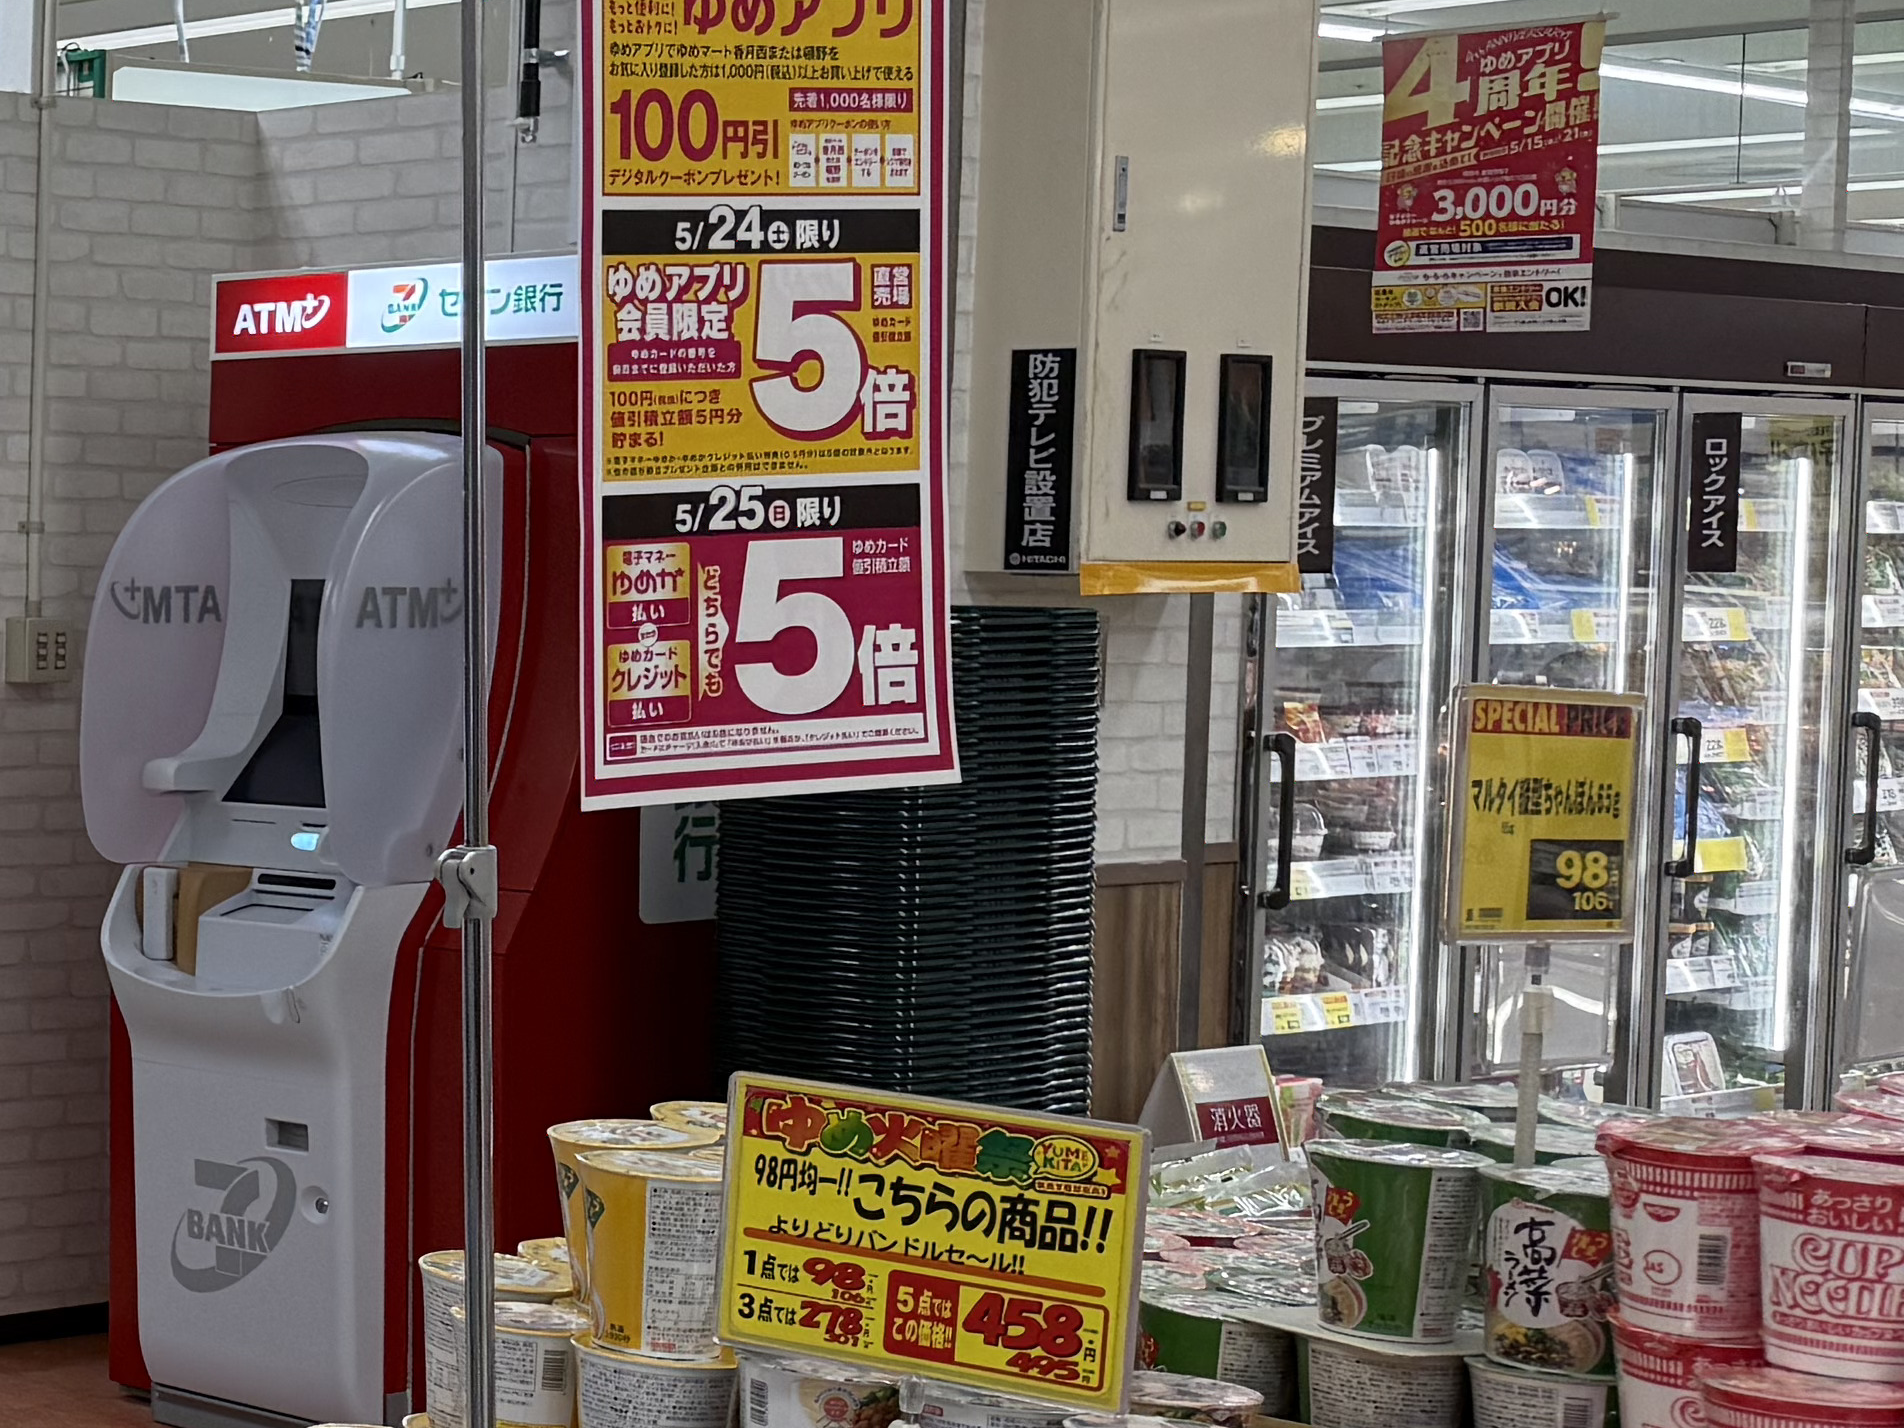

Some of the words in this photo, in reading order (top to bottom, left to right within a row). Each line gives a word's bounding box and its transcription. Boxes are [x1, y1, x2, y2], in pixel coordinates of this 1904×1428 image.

[1479, 40, 1571, 74] ゆめアプリ
[793, 92, 908, 109] 先着1,000名様限り
[609, 88, 780, 162] 100円引
[608, 169, 780, 188] デジタルクーポンプレゼント!
[1431, 182, 1578, 222] 3,000円分
[607, 263, 747, 302] ゆめアプリ
[1545, 285, 1587, 308] OK!
[616, 302, 730, 341] 会員限定
[611, 432, 664, 448] 貯まる!
[1020, 352, 1060, 548] 防犯テレビ設置店
[1297, 414, 1325, 556] プレミアムアイス
[1700, 437, 1728, 548] ロックアイス
[622, 550, 677, 565] 電子マネー
[852, 538, 909, 554] ゆめカード
[1022, 553, 1067, 565] HITACHI
[631, 603, 665, 622] 払い
[704, 565, 723, 698] どちらでも
[618, 647, 678, 663] ゆめカード
[611, 664, 688, 692] クレジット
[631, 701, 664, 720] 払い
[1474, 700, 1561, 733] SPECIAL
[1556, 850, 1610, 890] 98
[1572, 891, 1609, 912] 106
[1210, 1103, 1262, 1132] 消火器
[754, 1153, 851, 1198] 98円均一!!
[853, 1171, 1114, 1254] こちらの商品!!
[1809, 1188, 1893, 1214] あっさり
[186, 1206, 276, 1253] BANK
[1805, 1208, 1894, 1232] おいしい
[743, 1249, 800, 1284] 1点では
[802, 1256, 868, 1292] 98
[1503, 1249, 1522, 1307] ラーメン
[1513, 1216, 1557, 1318] 高菜
[736, 1292, 797, 1327] 3点では
[798, 1300, 865, 1338] 278
[896, 1285, 953, 1317] 5点では
[891, 1319, 953, 1351] この価格!!
[961, 1292, 1085, 1359] 458
[1005, 1351, 1081, 1382] 495
